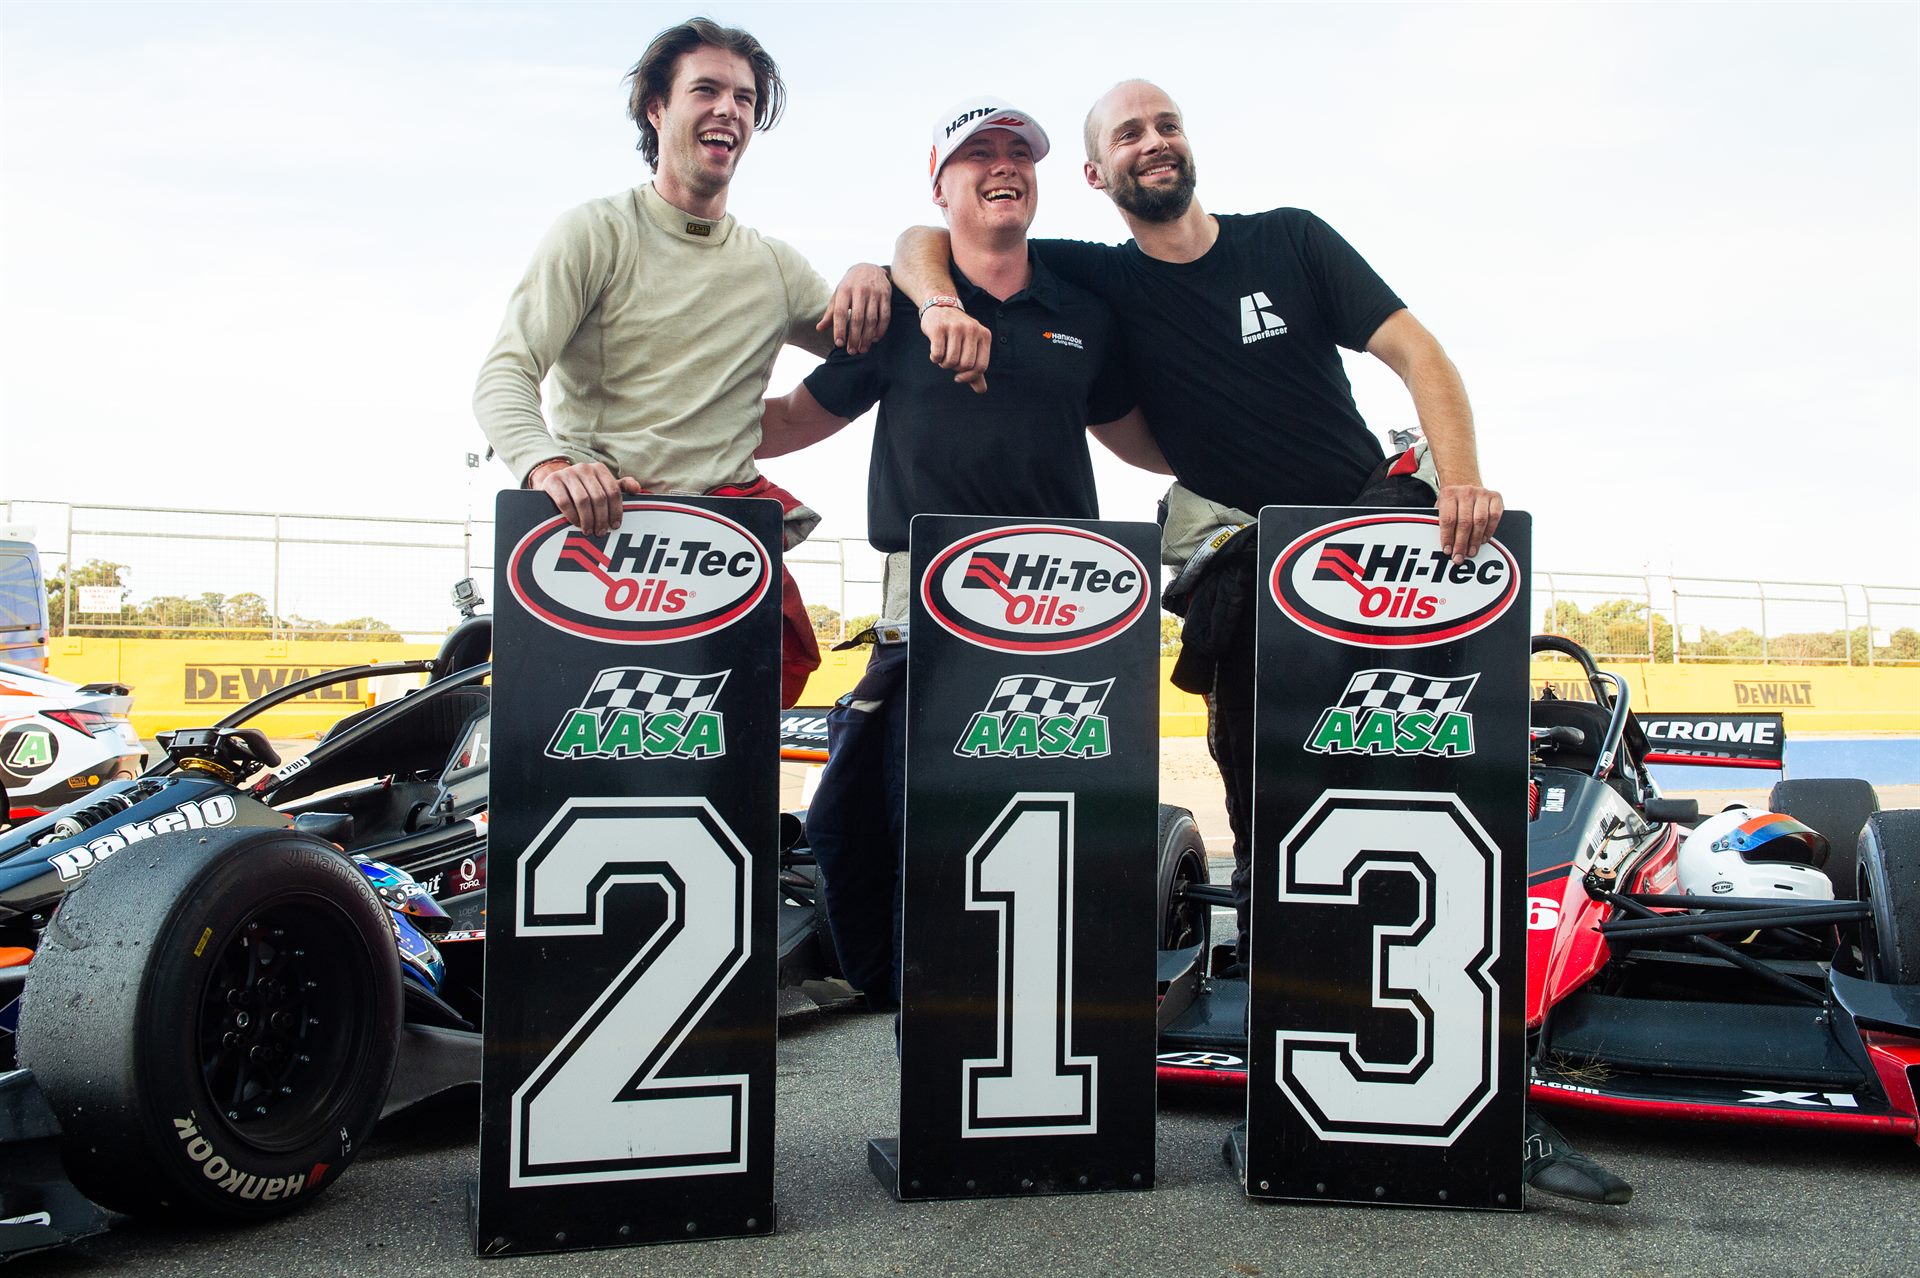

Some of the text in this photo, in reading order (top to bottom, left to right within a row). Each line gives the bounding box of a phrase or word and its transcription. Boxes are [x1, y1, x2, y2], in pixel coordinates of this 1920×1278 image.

[1242, 327, 1288, 345] HyperRacer
[607, 532, 755, 577] Hi-Tec
[1007, 553, 1137, 594] Hi-Tec
[1361, 543, 1504, 584] Hi-Tec
[605, 577, 689, 613] Oils
[1005, 594, 1078, 627] Oils
[1359, 586, 1439, 619] Oils
[544, 707, 726, 760] AASA
[953, 710, 1111, 760] AASA
[1303, 706, 1475, 758] AASA
[285, 758, 307, 773] PULL
[48, 795, 236, 882] pakelo
[459, 878, 481, 891] TORQ
[1527, 896, 1560, 930] 6
[962, 791, 1098, 1138] 1
[1275, 788, 1501, 1147] 3
[510, 796, 753, 1188] 2
[1530, 1078, 1599, 1095] r.com
[1738, 1089, 1858, 1107] X1
